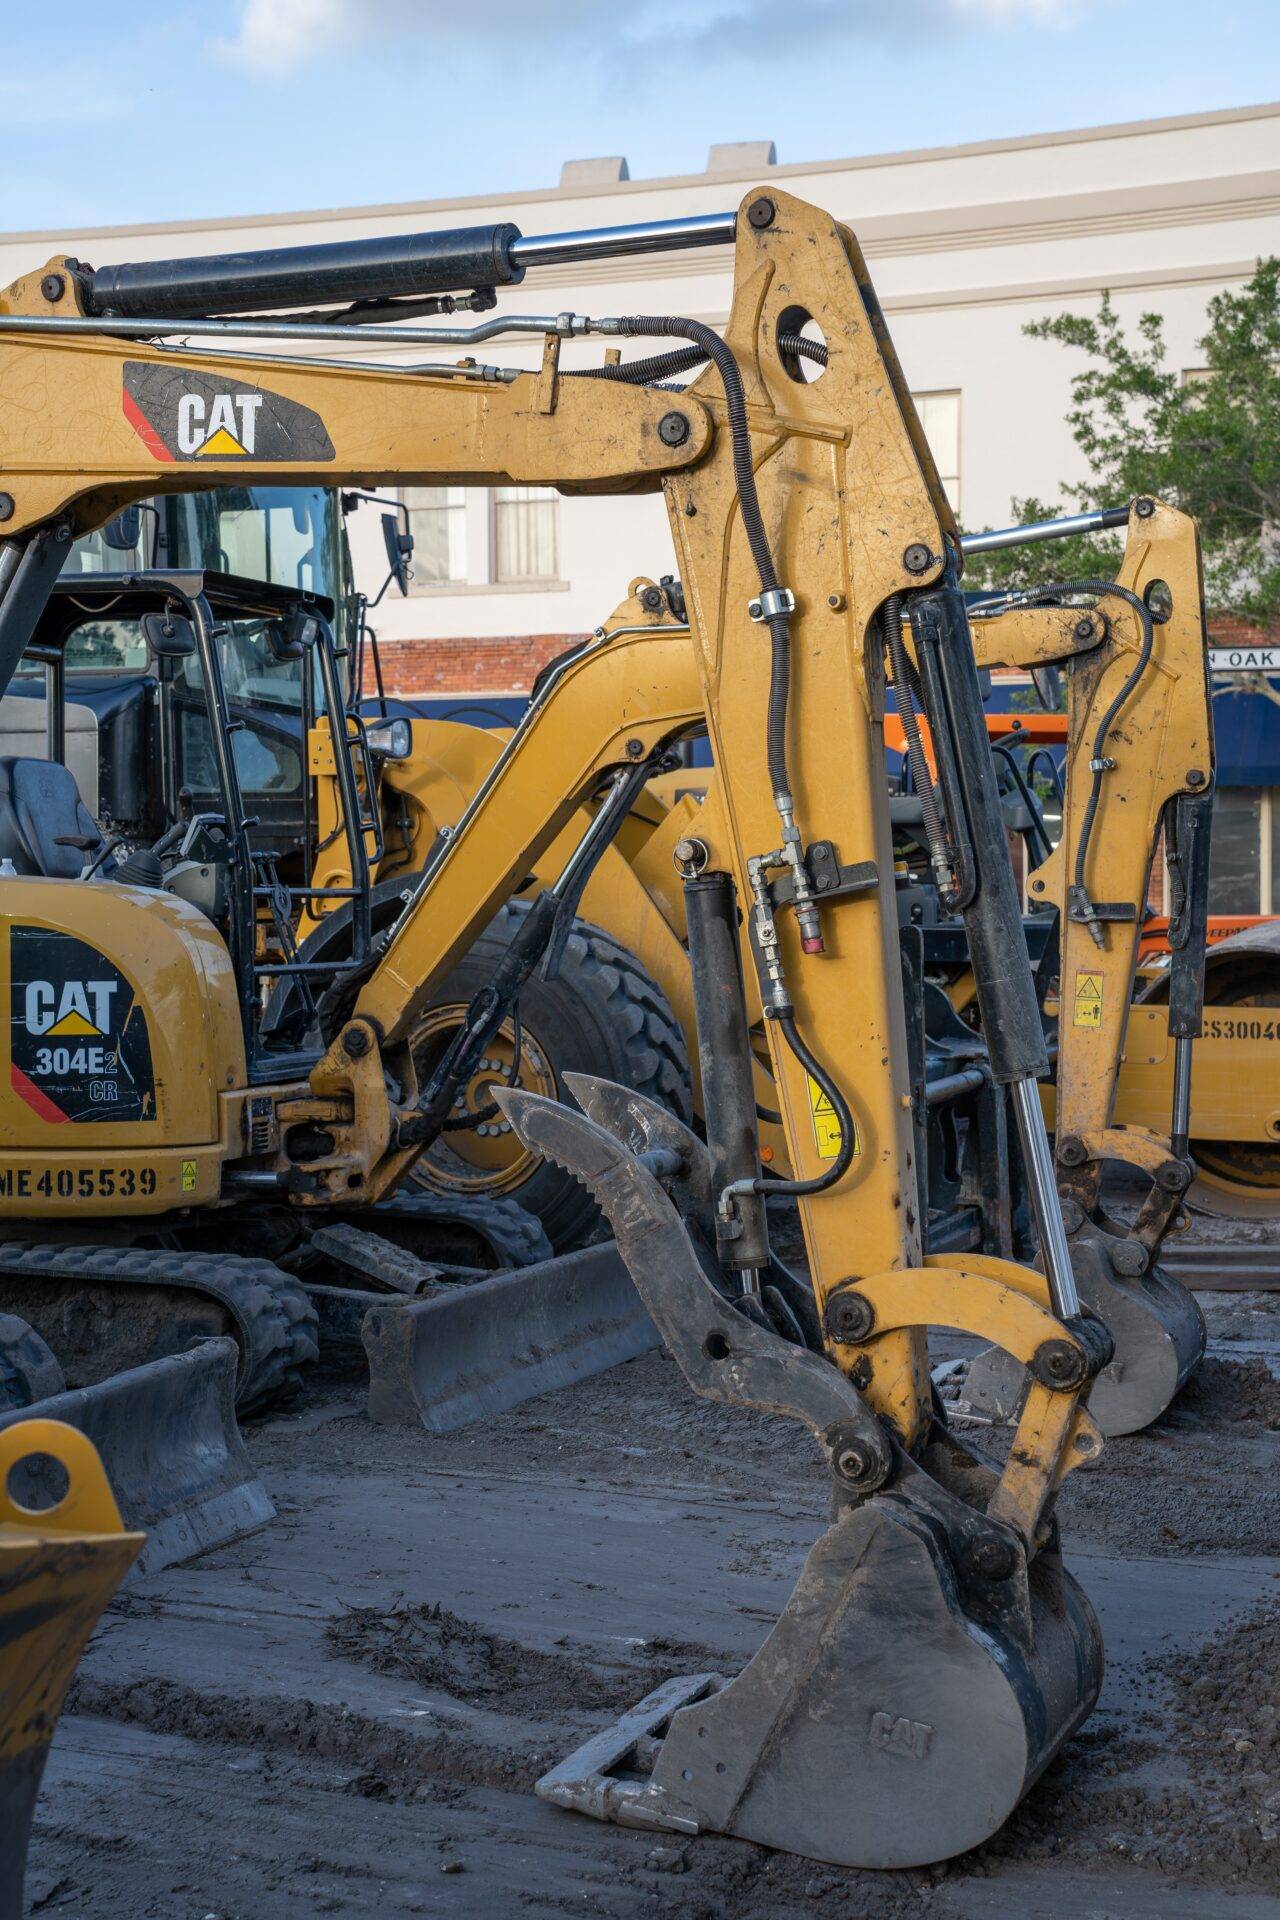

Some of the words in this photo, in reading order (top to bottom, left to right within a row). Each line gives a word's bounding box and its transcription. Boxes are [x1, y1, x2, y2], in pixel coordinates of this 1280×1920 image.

[178, 393, 263, 455] CAT
[1229, 652, 1273, 667] OAK
[25, 980, 118, 1036] CAT
[89, 1080, 118, 1102] CR
[870, 1711, 936, 1760] CAT
